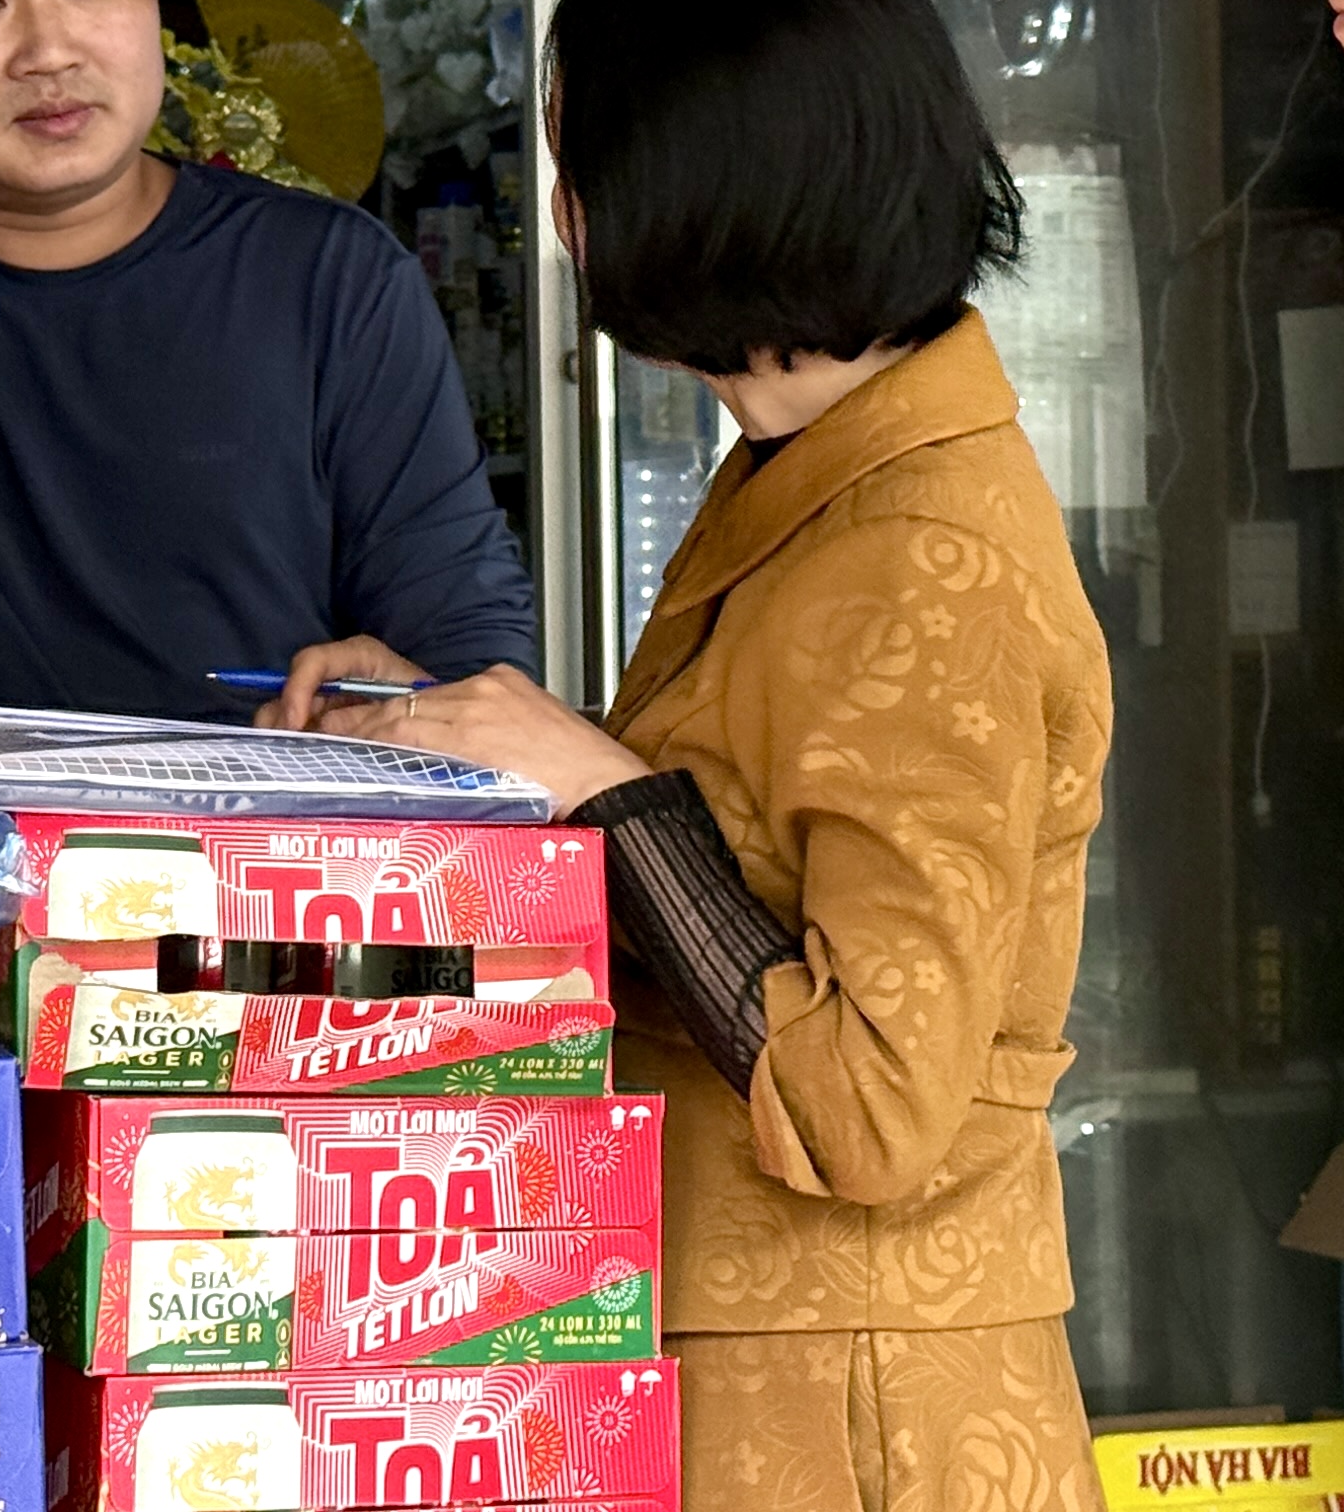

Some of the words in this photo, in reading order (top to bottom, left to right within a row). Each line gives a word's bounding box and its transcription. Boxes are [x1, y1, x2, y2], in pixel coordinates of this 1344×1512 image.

[269, 834, 321, 861] MỘT
[135, 1010, 177, 1024] BIA
[88, 1024, 220, 1049] SAIGON
[94, 1050, 204, 1068] LAGER
[286, 1040, 354, 1081] TẾT
[350, 1110, 399, 1138] MỘT
[191, 1272, 233, 1289] BIA
[148, 1291, 274, 1321] SAIGON
[156, 1322, 264, 1345] LAGER
[342, 1306, 404, 1360] TẾT
[539, 1316, 555, 1332] 24
[559, 1316, 584, 1332] LON
[598, 1315, 622, 1331] 330
[625, 1315, 642, 1330] ML
[1259, 1443, 1312, 1480] BIA
